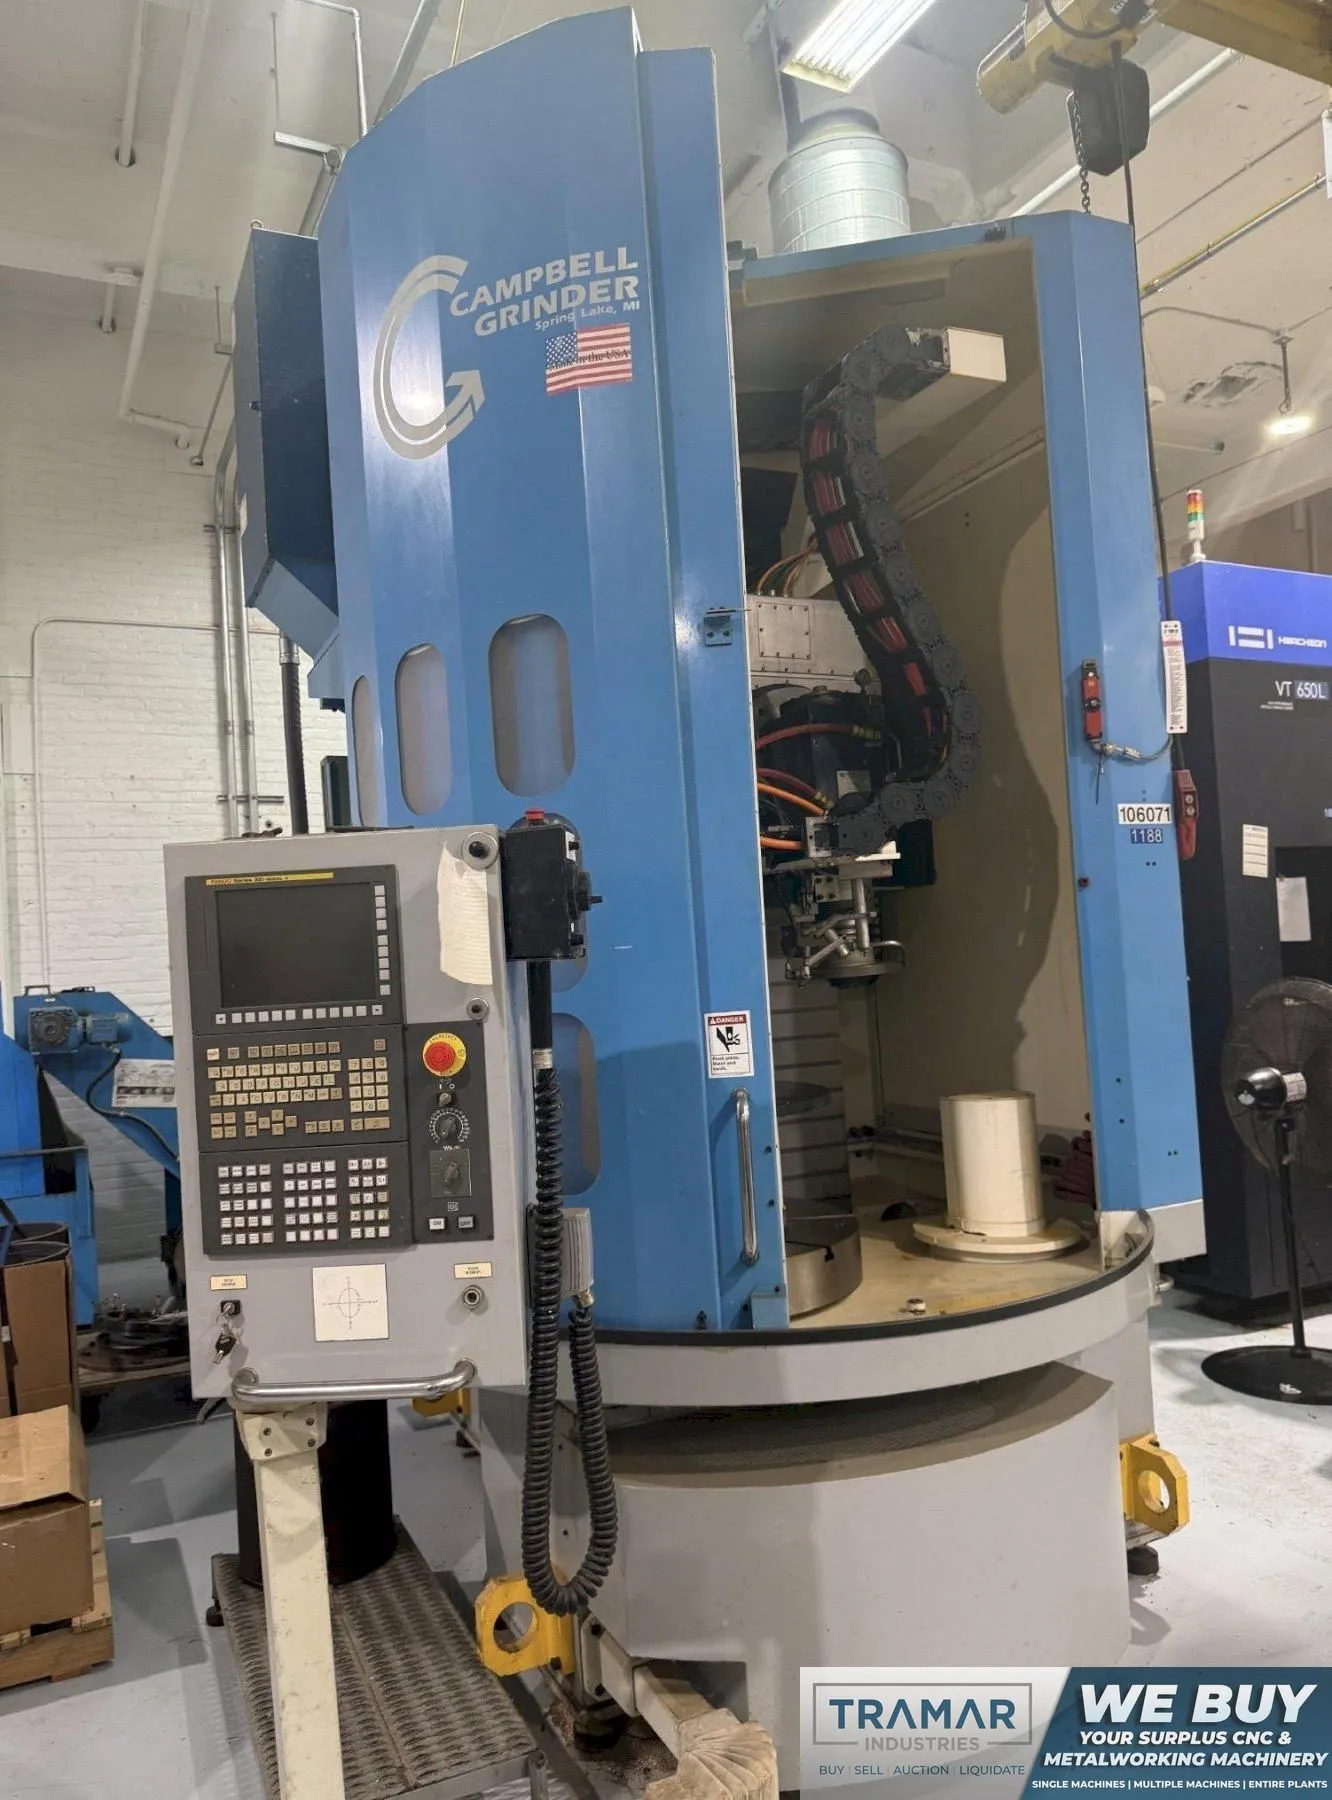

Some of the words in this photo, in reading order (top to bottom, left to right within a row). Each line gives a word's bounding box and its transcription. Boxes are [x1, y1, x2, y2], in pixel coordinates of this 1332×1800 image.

[450, 247, 639, 317] CAMPBELL
[475, 275, 639, 336] GRINDER
[535, 311, 576, 332] Spring
[581, 305, 617, 319] Lake,
[623, 300, 640, 312] MI
[588, 352, 605, 362] the
[606, 349, 629, 360] USA
[1275, 680, 1293, 697] VT
[1296, 682, 1327, 699] 650L
[1119, 807, 1170, 822] 106071
[1131, 828, 1163, 843] 1188
[716, 1016, 744, 1024] DANGER
